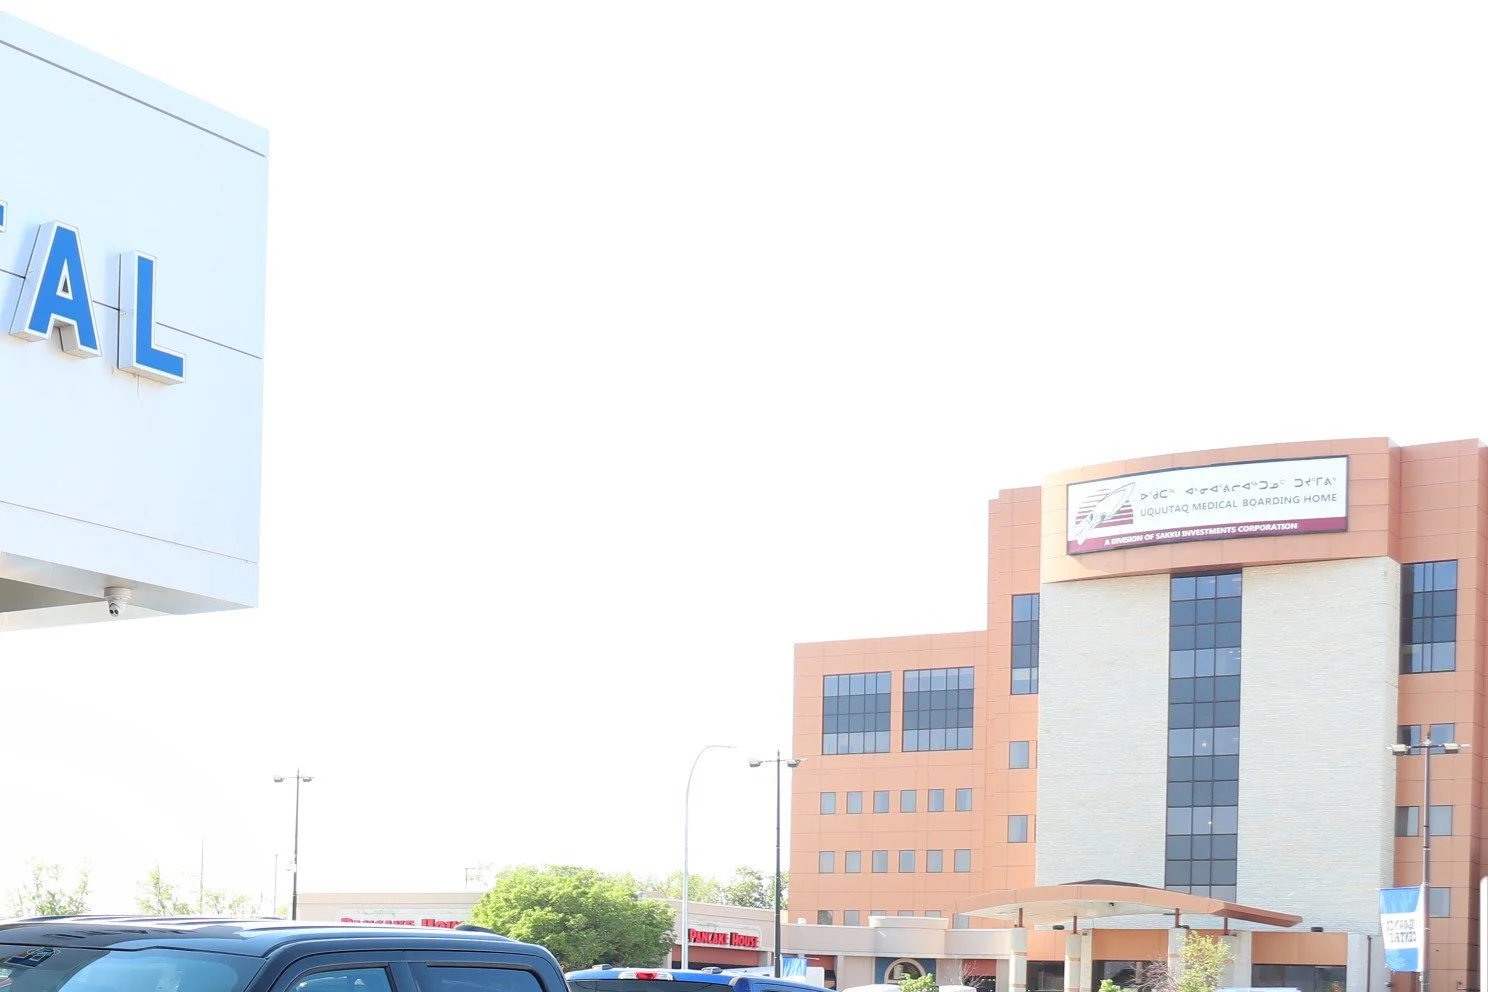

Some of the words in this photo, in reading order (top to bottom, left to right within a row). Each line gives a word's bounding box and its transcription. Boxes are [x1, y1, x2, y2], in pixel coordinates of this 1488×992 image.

[1140, 503, 1190, 517] UQUUTAQ
[1192, 500, 1238, 511] MEDICAL
[1242, 495, 1300, 507] BOARDING
[1303, 494, 1338, 503] HOME
[1111, 535, 1143, 544] DIVISION
[1144, 533, 1155, 541] OF
[1155, 530, 1181, 540] SAKKU
[1181, 526, 1237, 537] INVESTMENTS
[1237, 522, 1299, 533] CORPORATION
[688, 928, 729, 945] PANCAKE
[730, 931, 760, 949] HOUSE
